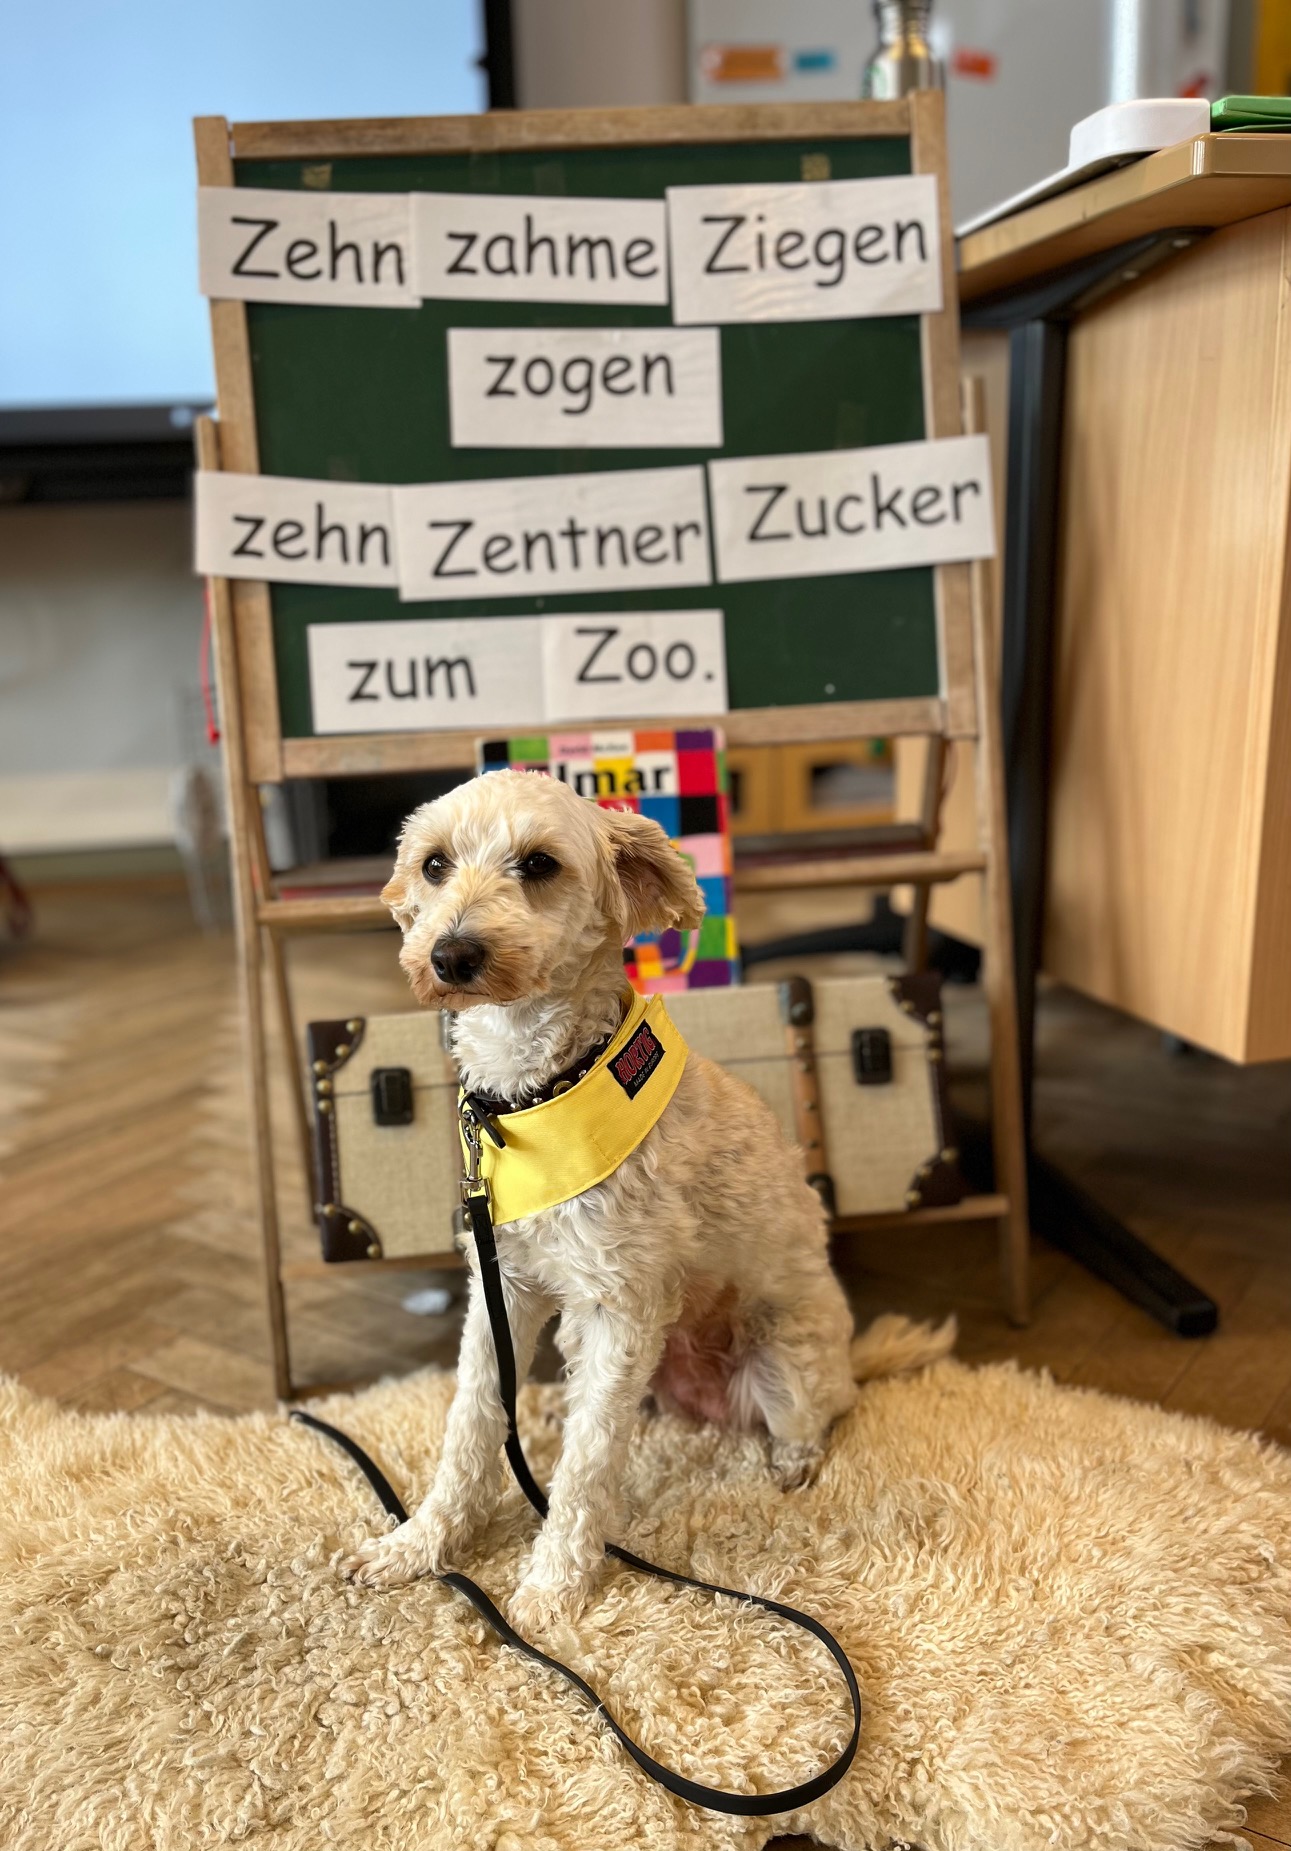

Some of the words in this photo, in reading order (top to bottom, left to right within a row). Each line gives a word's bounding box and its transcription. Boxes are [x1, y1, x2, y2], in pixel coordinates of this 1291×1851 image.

[230, 216, 405, 285] Zehn
[446, 214, 659, 279] zahme
[702, 215, 926, 288] Ziegen
[486, 354, 674, 415] zogen
[232, 503, 390, 566] zehn
[429, 518, 702, 578] Zentner
[745, 475, 980, 542] Zucker
[348, 657, 475, 702] zum
[576, 628, 715, 683] Zoo.
[524, 762, 671, 797] lmar
